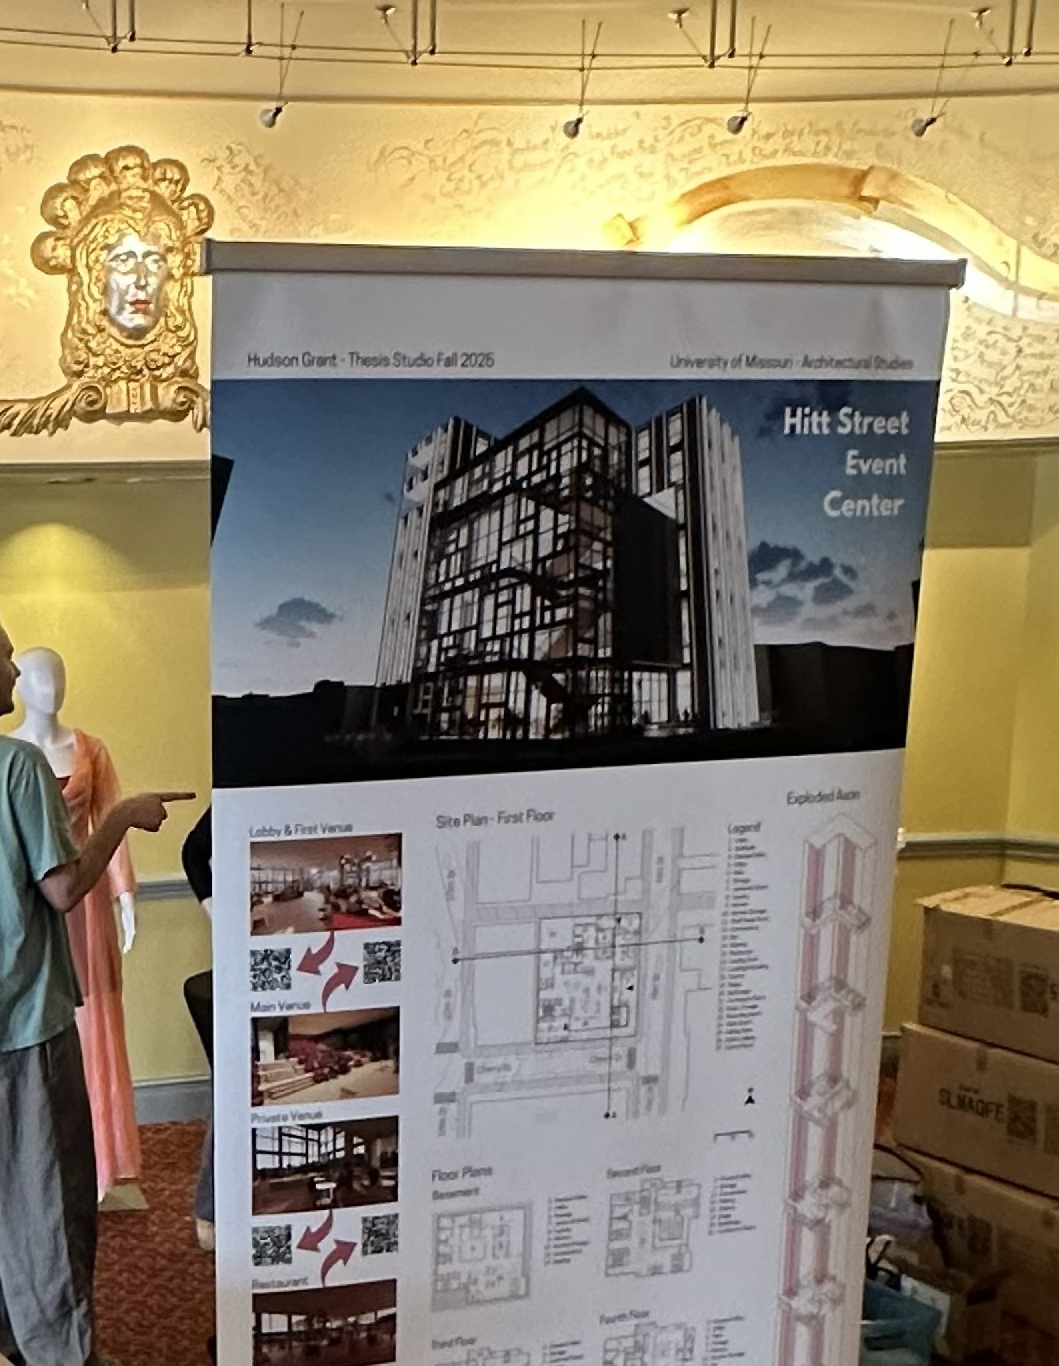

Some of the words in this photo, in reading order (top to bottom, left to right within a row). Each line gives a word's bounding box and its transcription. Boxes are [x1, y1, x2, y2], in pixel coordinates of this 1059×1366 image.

[247, 351, 298, 368] Hudson
[301, 351, 337, 368] Grant
[348, 351, 390, 368] Thesis
[393, 351, 434, 368] Studio
[436, 351, 459, 368] Fall
[669, 353, 728, 372] University
[730, 353, 742, 369] of
[801, 354, 872, 371] Architectural
[783, 406, 832, 435] Hitt
[837, 405, 909, 435] Street
[845, 449, 907, 476] Event
[823, 489, 905, 518] Center
[436, 815, 461, 829] Site
[463, 813, 489, 827] Plan
[497, 811, 524, 825] First
[527, 810, 556, 824] Floor
[249, 825, 282, 839] Lobby
[294, 823, 319, 836] First
[320, 822, 353, 835] Venue
[250, 1000, 276, 1014] Main
[277, 1000, 312, 1012] Venue
[289, 1109, 323, 1121] Venue
[431, 1168, 459, 1183] Floor
[461, 1165, 492, 1179] Plans
